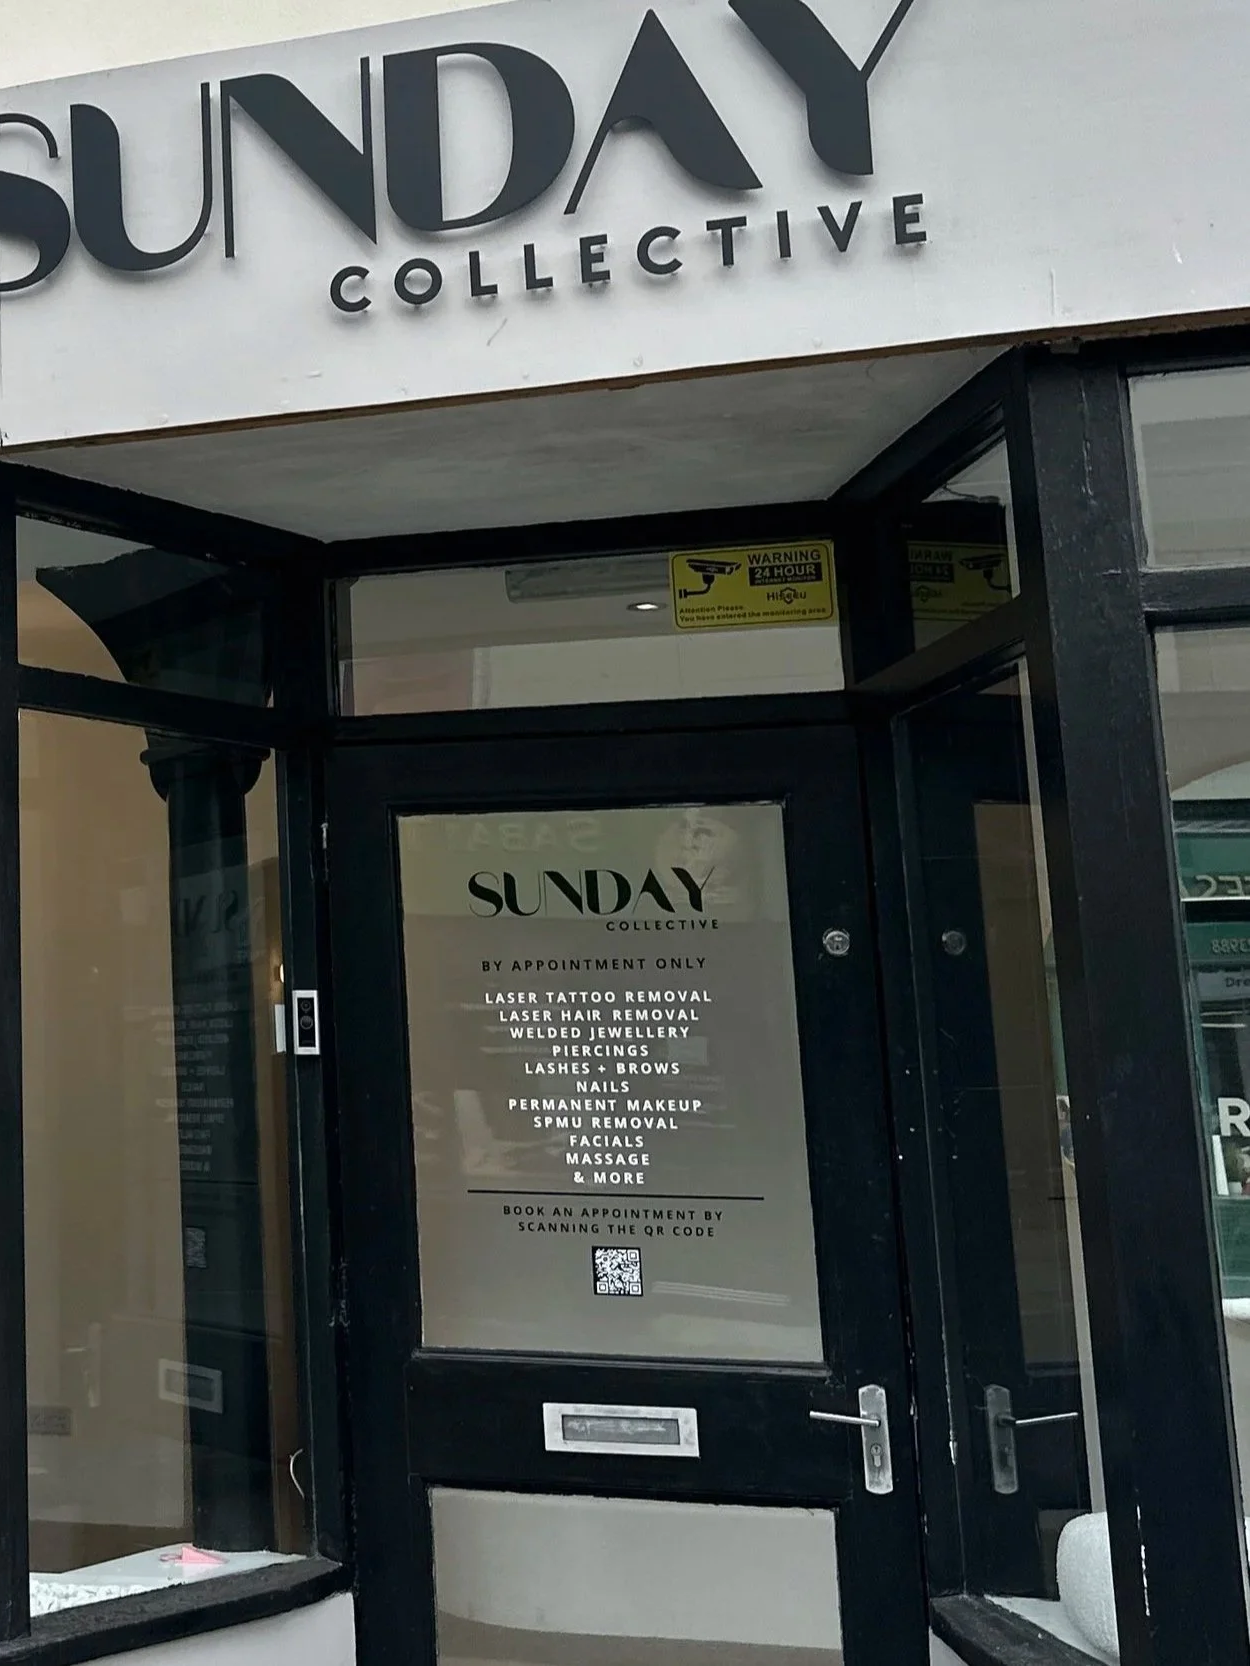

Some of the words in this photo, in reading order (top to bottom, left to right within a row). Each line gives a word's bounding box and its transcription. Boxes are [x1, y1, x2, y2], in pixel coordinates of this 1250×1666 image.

[330, 193, 927, 313] COLLECTIVE
[748, 549, 821, 565] WARNING
[754, 568, 771, 580] 24
[774, 564, 817, 577] HOUR
[467, 866, 716, 918] SUNDAY
[605, 919, 719, 932] COLLECTIVE
[481, 960, 502, 972] BY
[511, 958, 646, 972] APPOINTMENT
[655, 957, 706, 970] ONLY
[485, 991, 538, 1004] LASER
[545, 991, 616, 1004] TATTOO
[625, 990, 712, 1003] REMOVAL
[499, 1010, 552, 1022] LASER
[561, 1009, 601, 1022] HAIR
[612, 1008, 699, 1021] REMOVAL
[509, 1026, 581, 1039] WELDED
[589, 1026, 689, 1042] JEWELLERY
[552, 1044, 649, 1057] PIERCINGS
[524, 1062, 590, 1075] LASHES
[597, 1065, 606, 1073] +
[616, 1062, 680, 1075] BROWS
[576, 1080, 630, 1093] NAILS
[508, 1098, 617, 1111] PERMANENT
[626, 1099, 702, 1112] MAKEUP
[533, 1116, 582, 1129] SPMU
[591, 1116, 678, 1130] REMOVAL
[569, 1134, 644, 1148] FACIALS
[565, 1152, 650, 1166] MASSAGE
[573, 1171, 585, 1184] &
[593, 1171, 644, 1185] MORE
[503, 1205, 545, 1216] BOOK
[552, 1207, 573, 1217] AN
[581, 1207, 695, 1221] APPOINTMENT
[704, 1210, 722, 1221] BY
[518, 1221, 600, 1234] SCANNING
[608, 1224, 636, 1235] THE
[643, 1225, 665, 1238] QR
[672, 1226, 714, 1238] CODE
